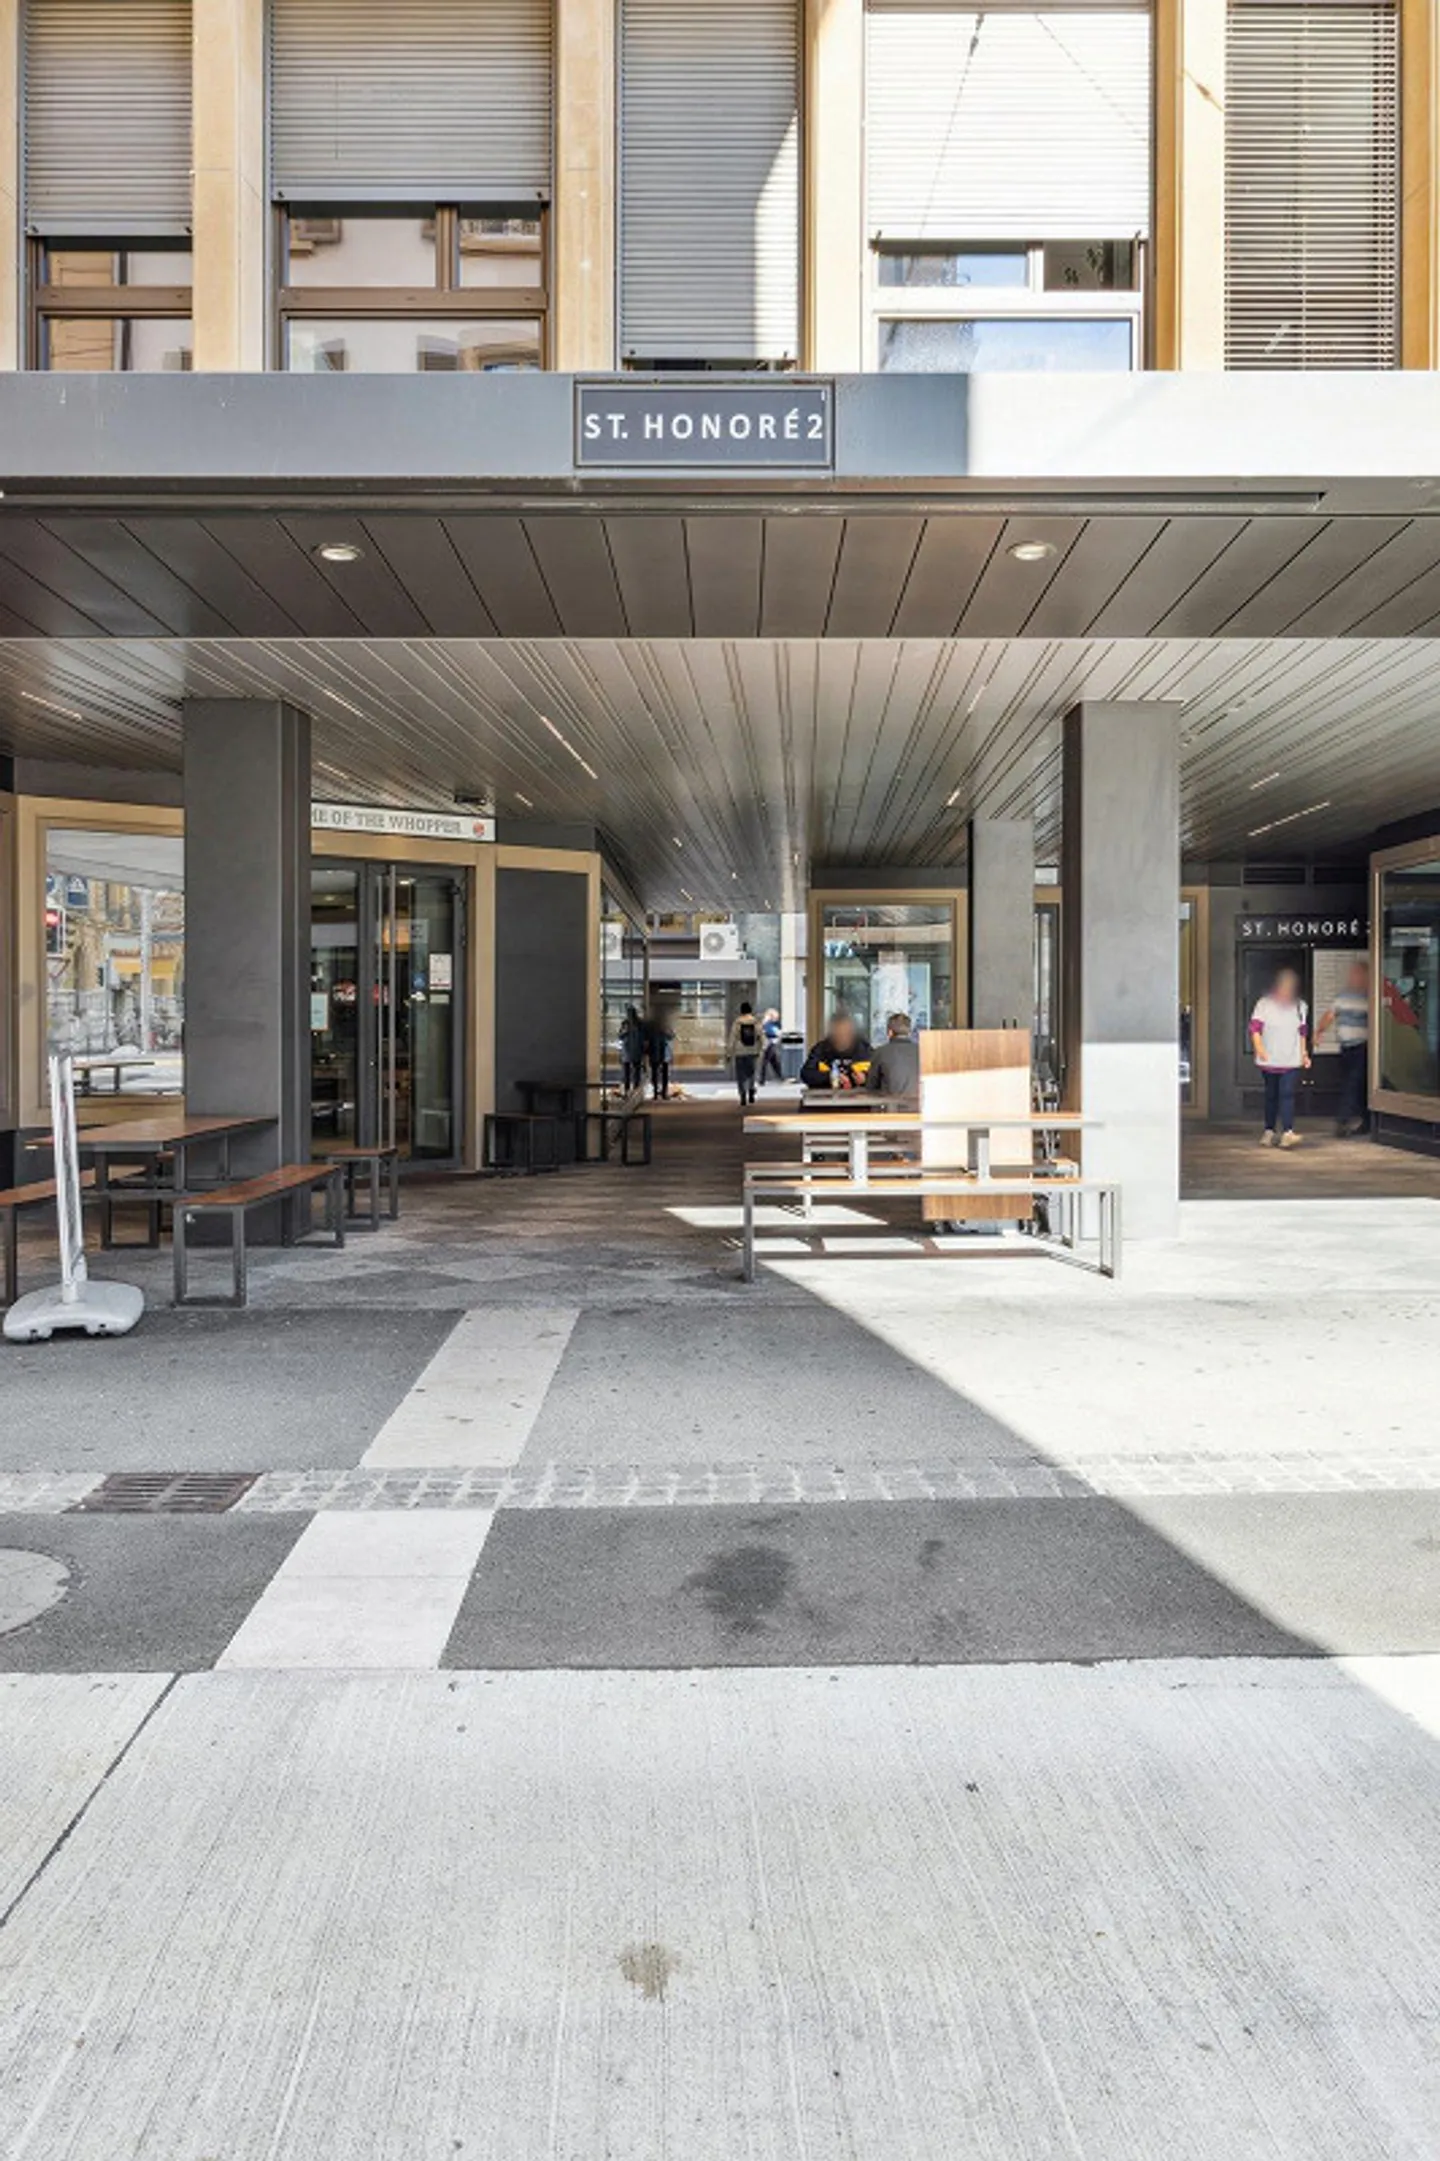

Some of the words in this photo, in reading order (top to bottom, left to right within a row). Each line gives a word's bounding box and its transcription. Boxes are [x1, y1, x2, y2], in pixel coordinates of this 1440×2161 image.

[584, 413, 629, 440] ST.
[332, 810, 354, 826] OF
[354, 812, 385, 828] THE
[389, 815, 462, 835] WHOPPER
[1242, 921, 1272, 937] ST.
[1278, 918, 1360, 937] HONORÉ
